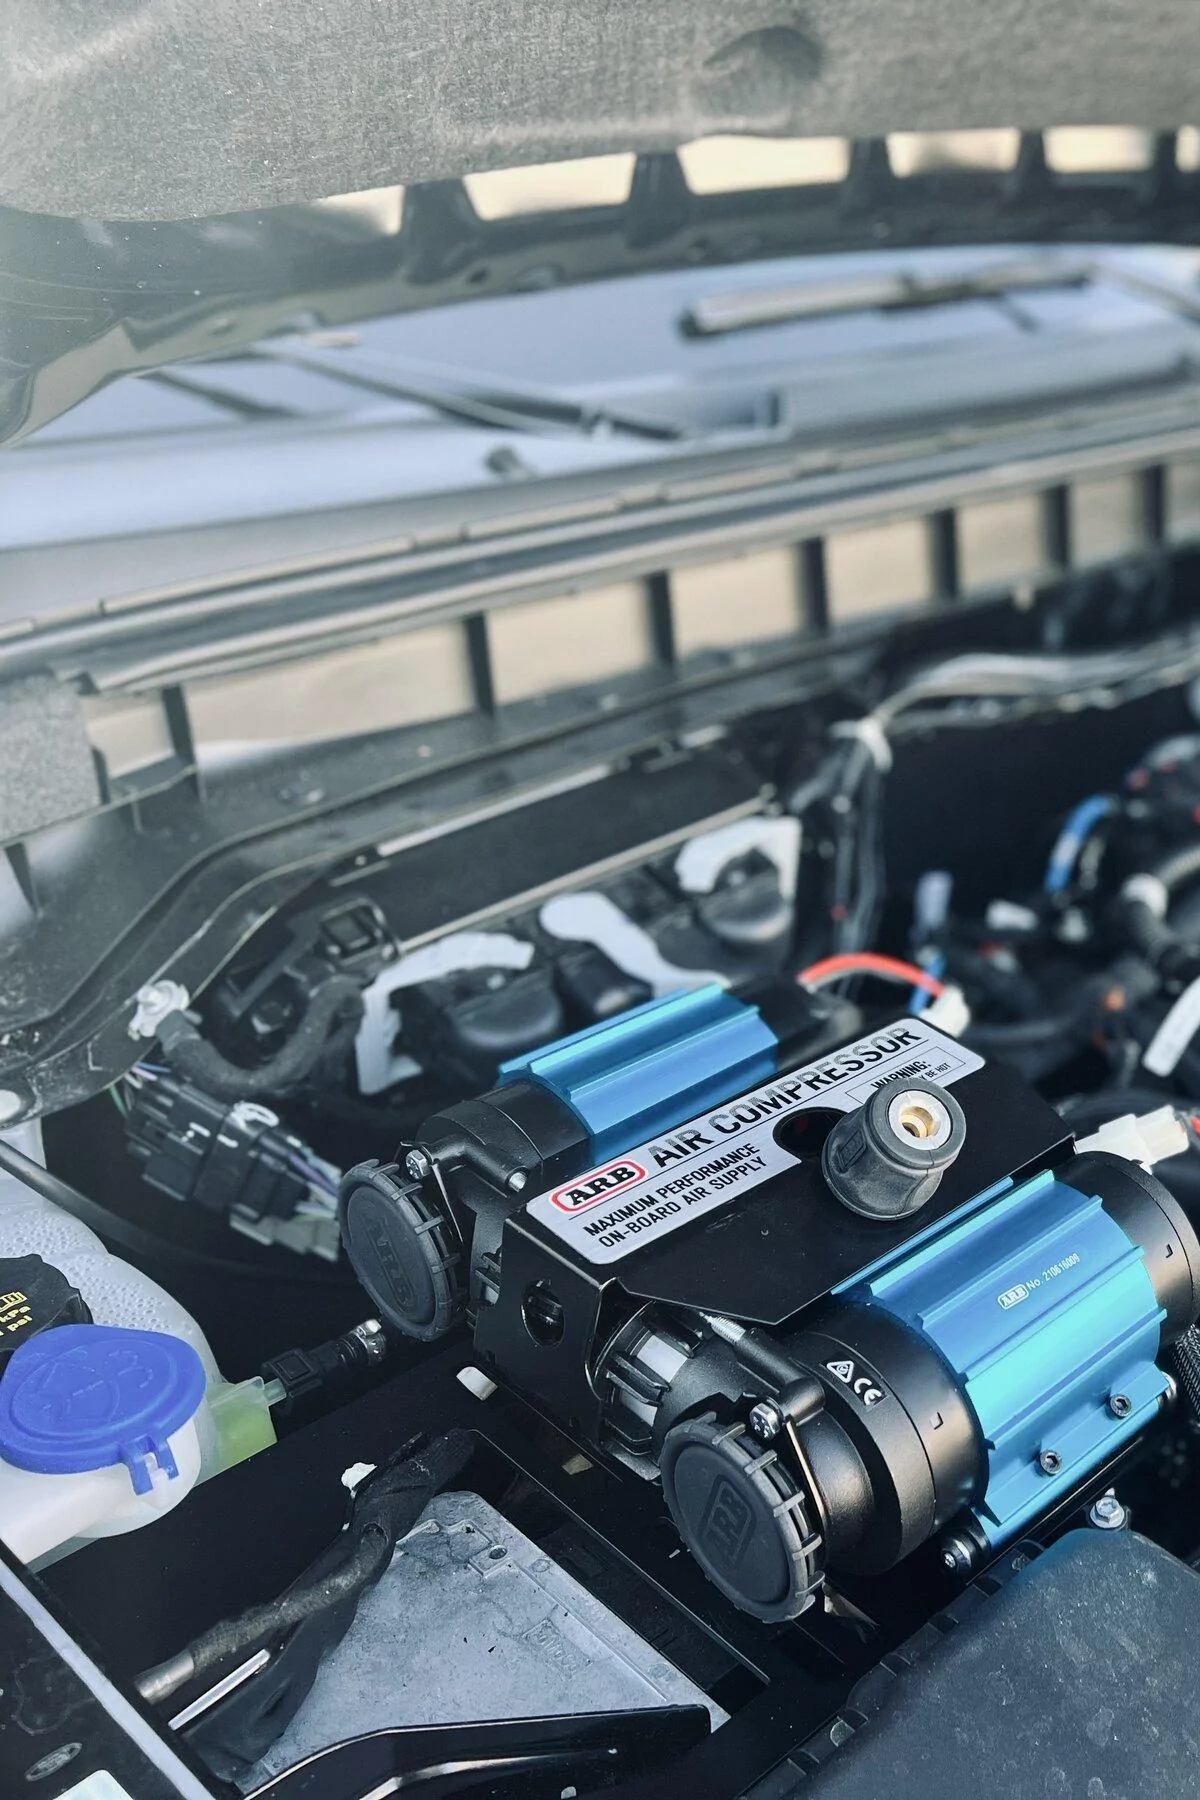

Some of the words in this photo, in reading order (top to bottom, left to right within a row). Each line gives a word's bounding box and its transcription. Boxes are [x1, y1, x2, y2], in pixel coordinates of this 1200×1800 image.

[648, 1128, 714, 1168] AIR
[708, 1027, 922, 1134] COMPRESSOR
[935, 1062, 951, 1073] HOT
[563, 1165, 637, 1206] ARB
[583, 1194, 660, 1237] MAXIMUM
[655, 1142, 761, 1199] PERFORMANCE
[598, 1199, 682, 1247] ON-BOARD
[686, 1186, 712, 1206] AIR
[708, 1155, 768, 1190] SUPPLY
